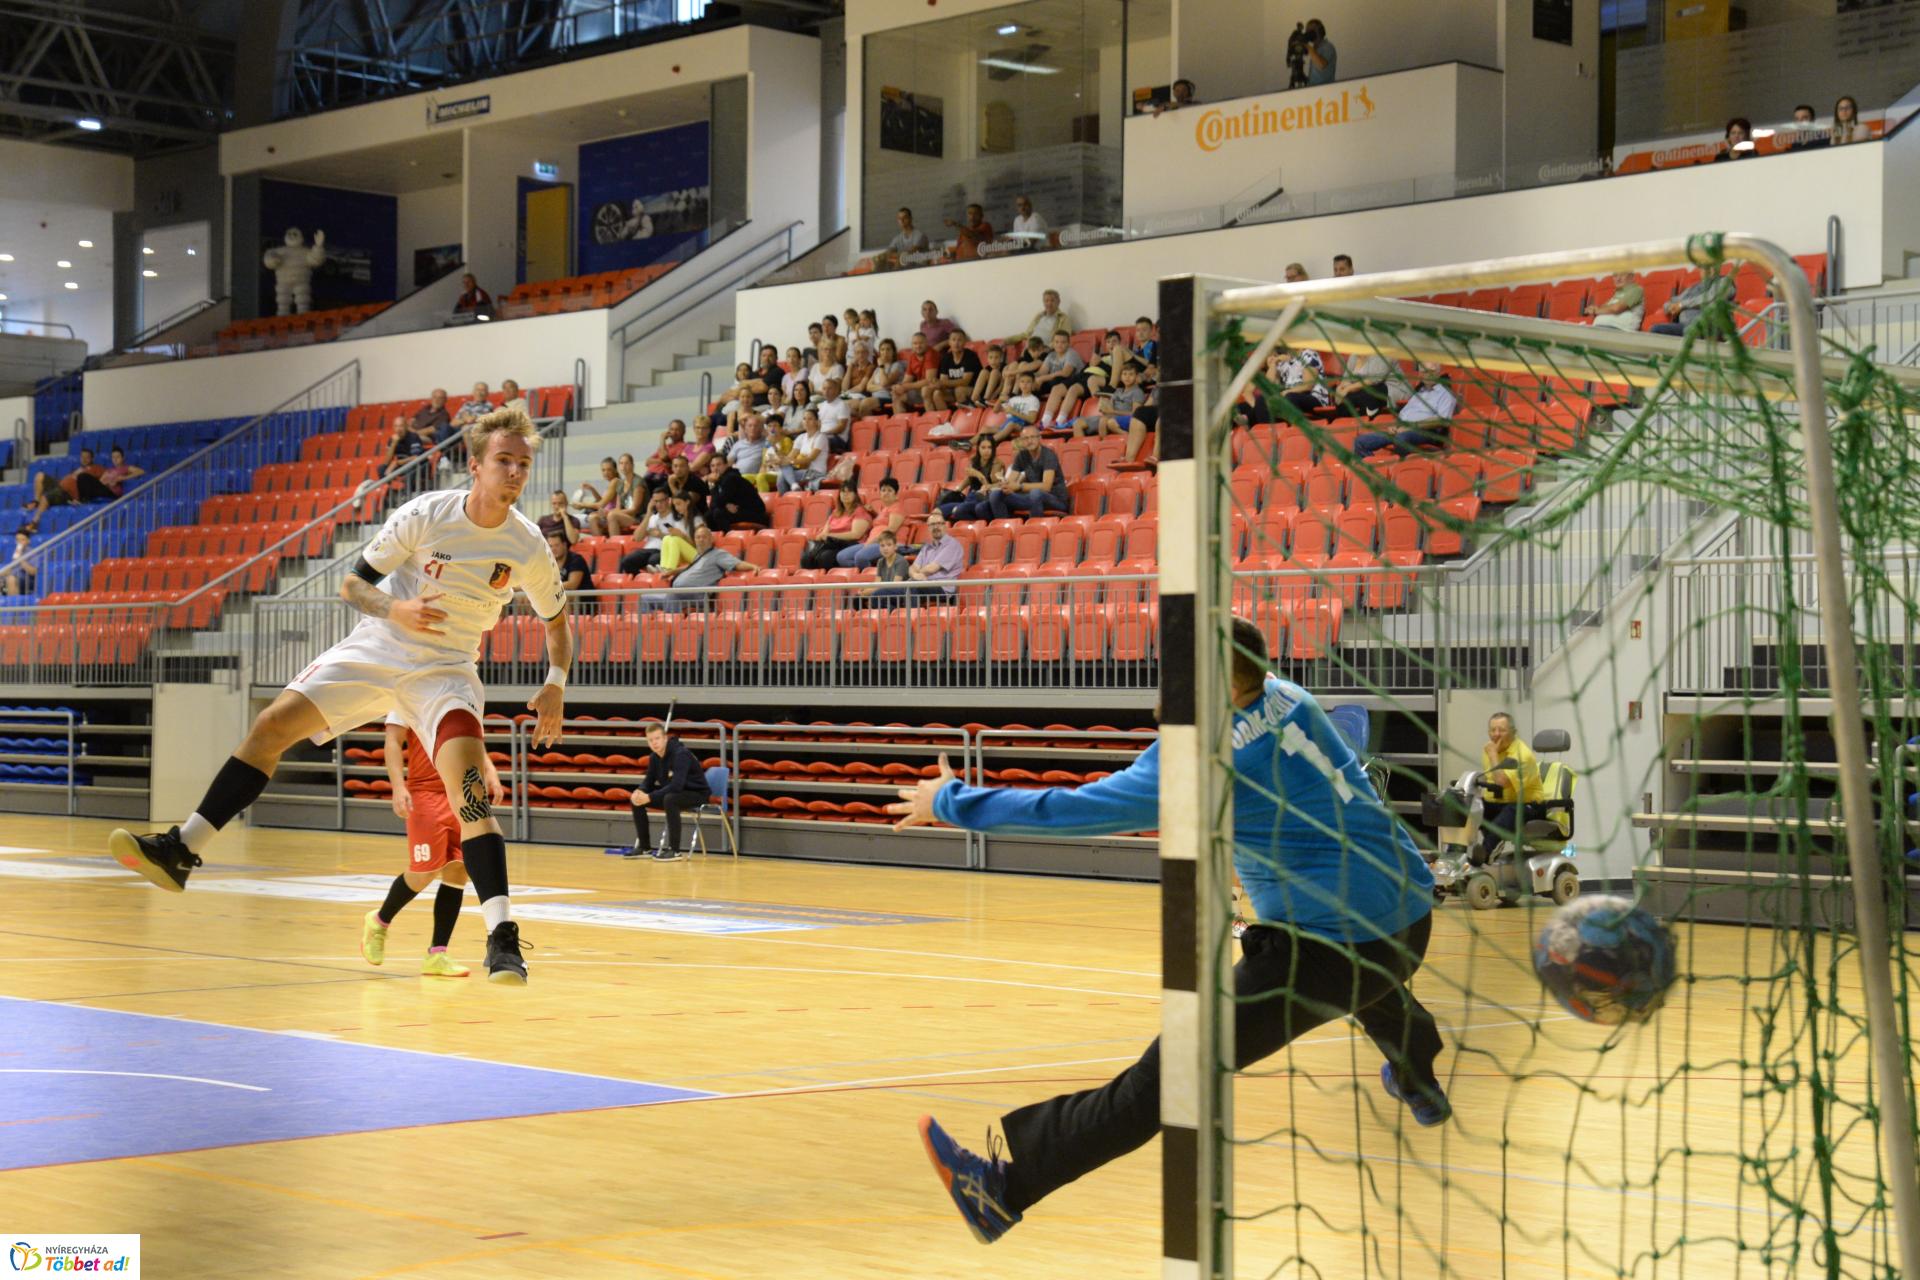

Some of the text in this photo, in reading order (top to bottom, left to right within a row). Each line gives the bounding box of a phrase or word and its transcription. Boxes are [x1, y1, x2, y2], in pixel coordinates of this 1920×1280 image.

[1195, 90, 1350, 152] Continental
[1538, 158, 1603, 180] Continental
[431, 551, 452, 561] JAKO
[414, 843, 431, 862] 69
